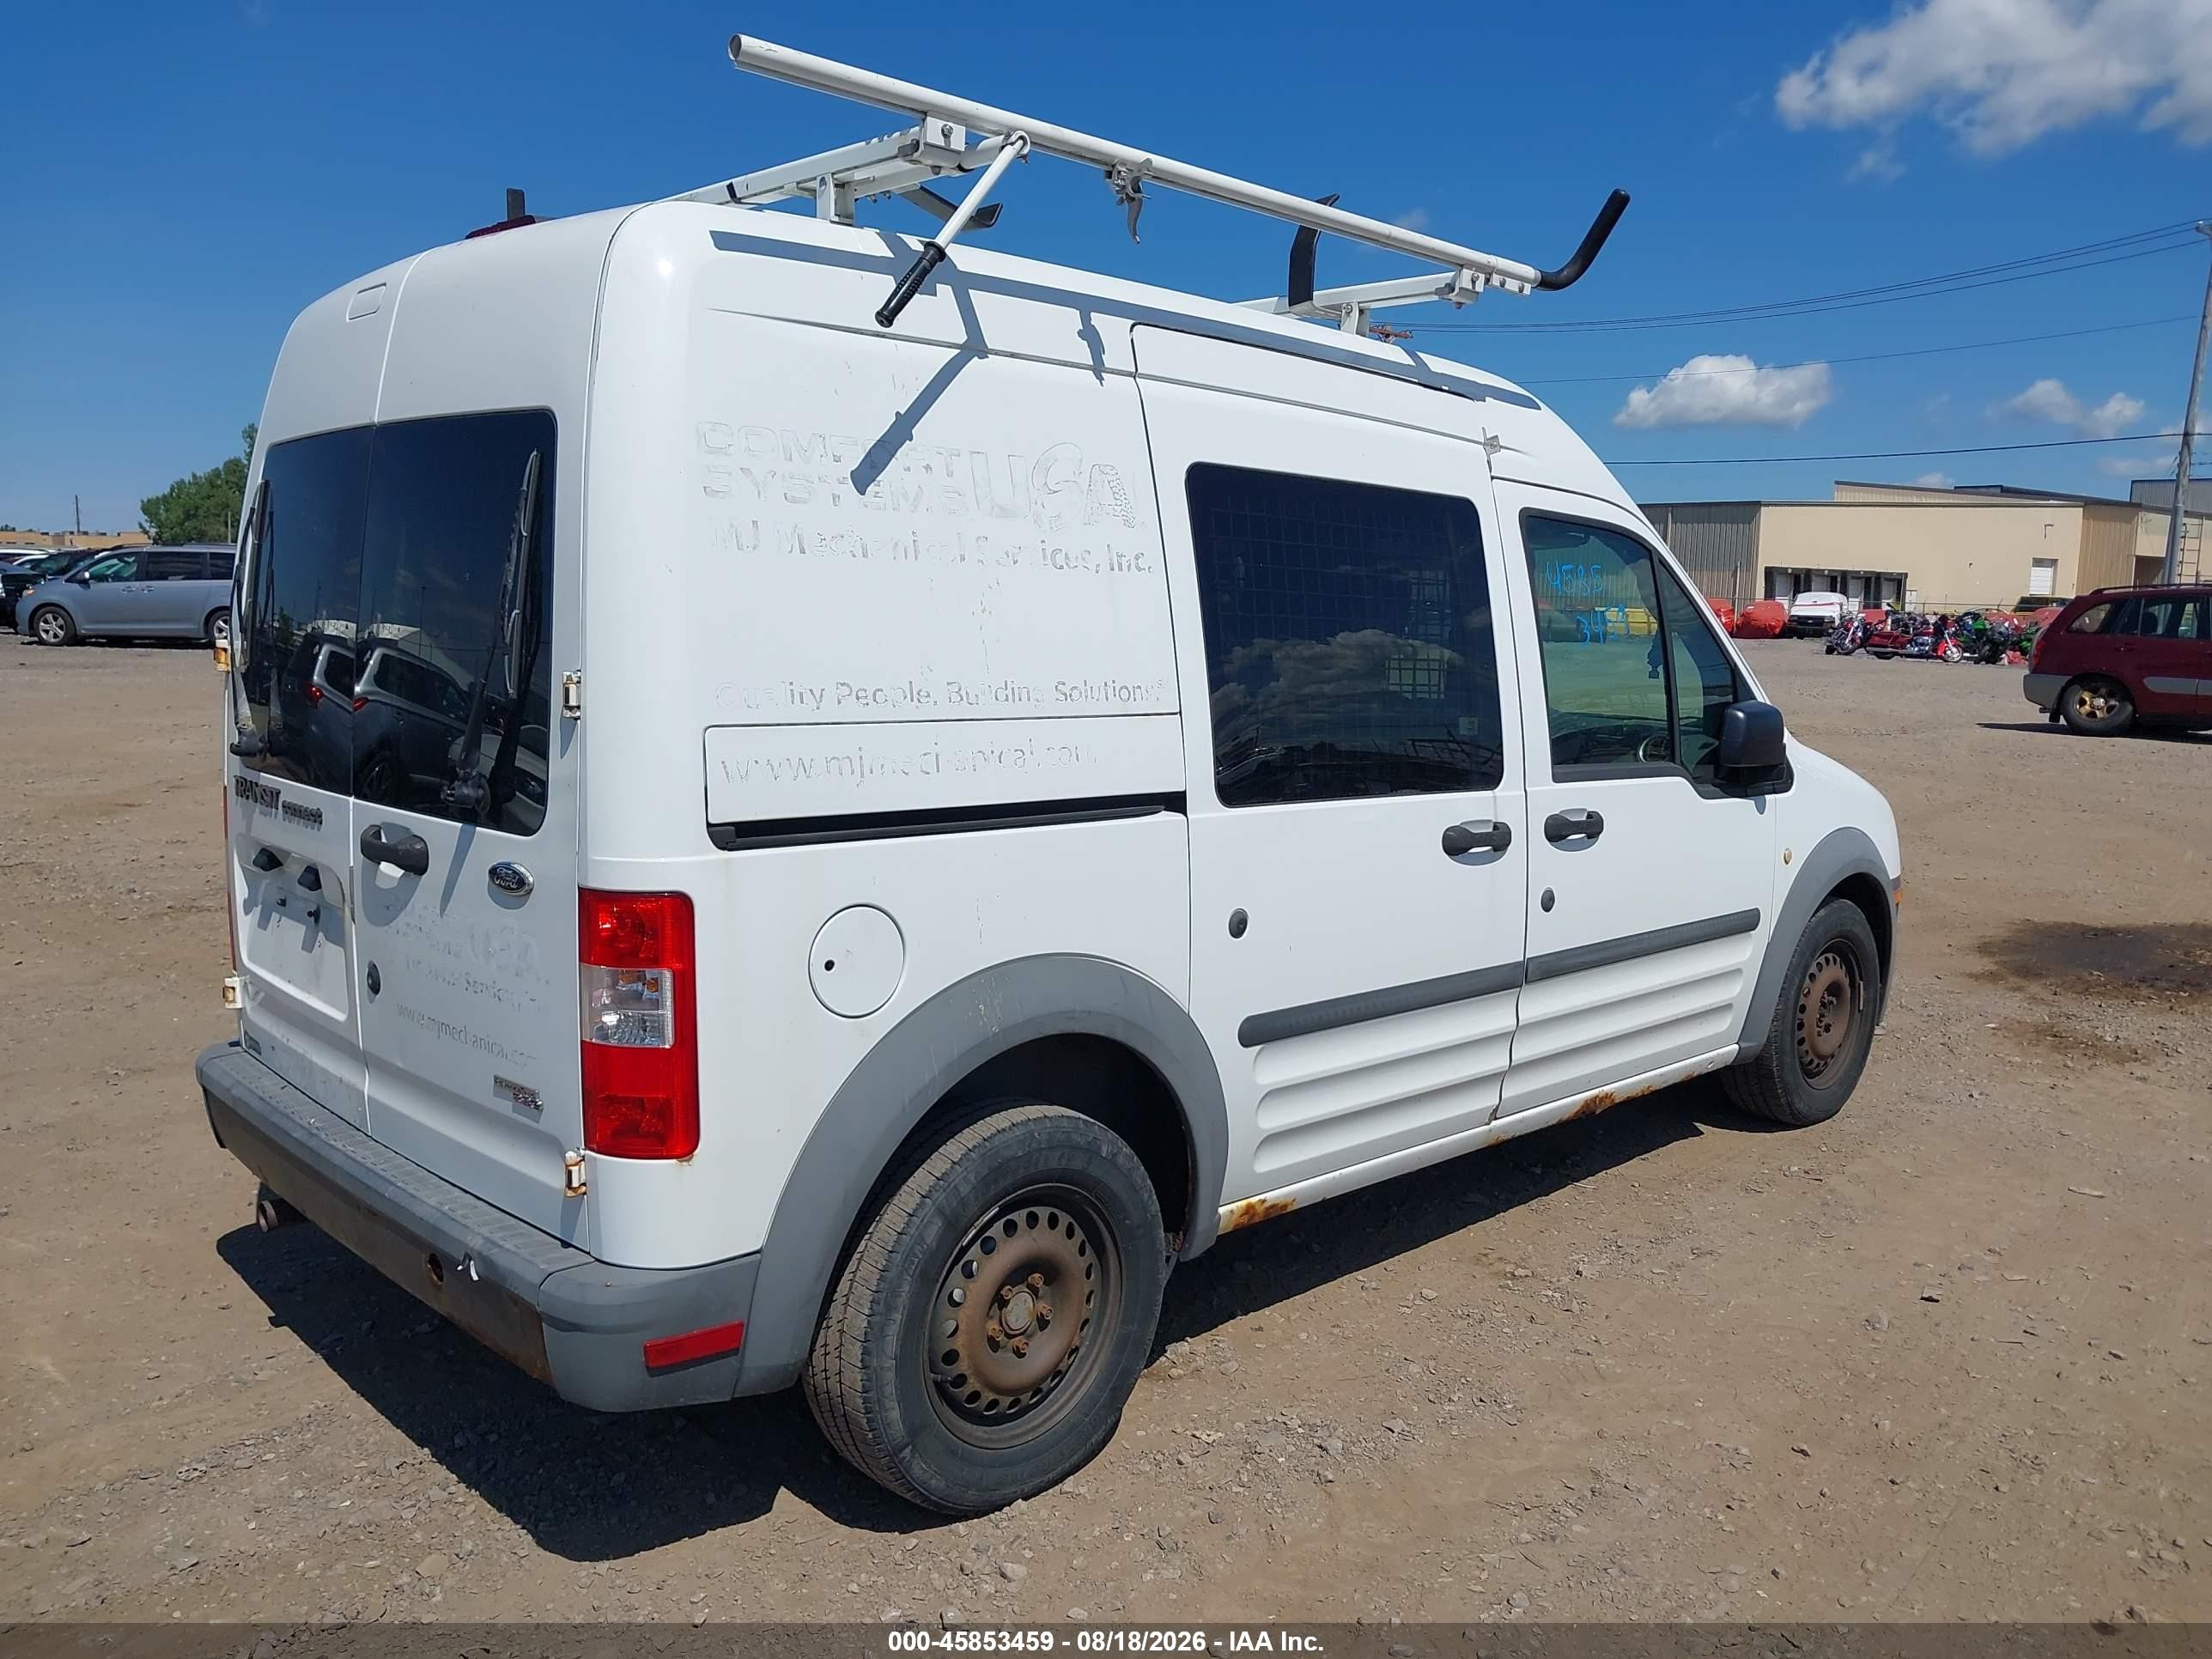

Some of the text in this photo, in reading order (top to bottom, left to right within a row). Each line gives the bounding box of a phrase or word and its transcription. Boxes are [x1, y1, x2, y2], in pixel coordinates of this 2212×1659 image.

[775, 521, 967, 567] Mechnical
[975, 534, 1102, 574] Serices,
[494, 866, 520, 889] Ford
